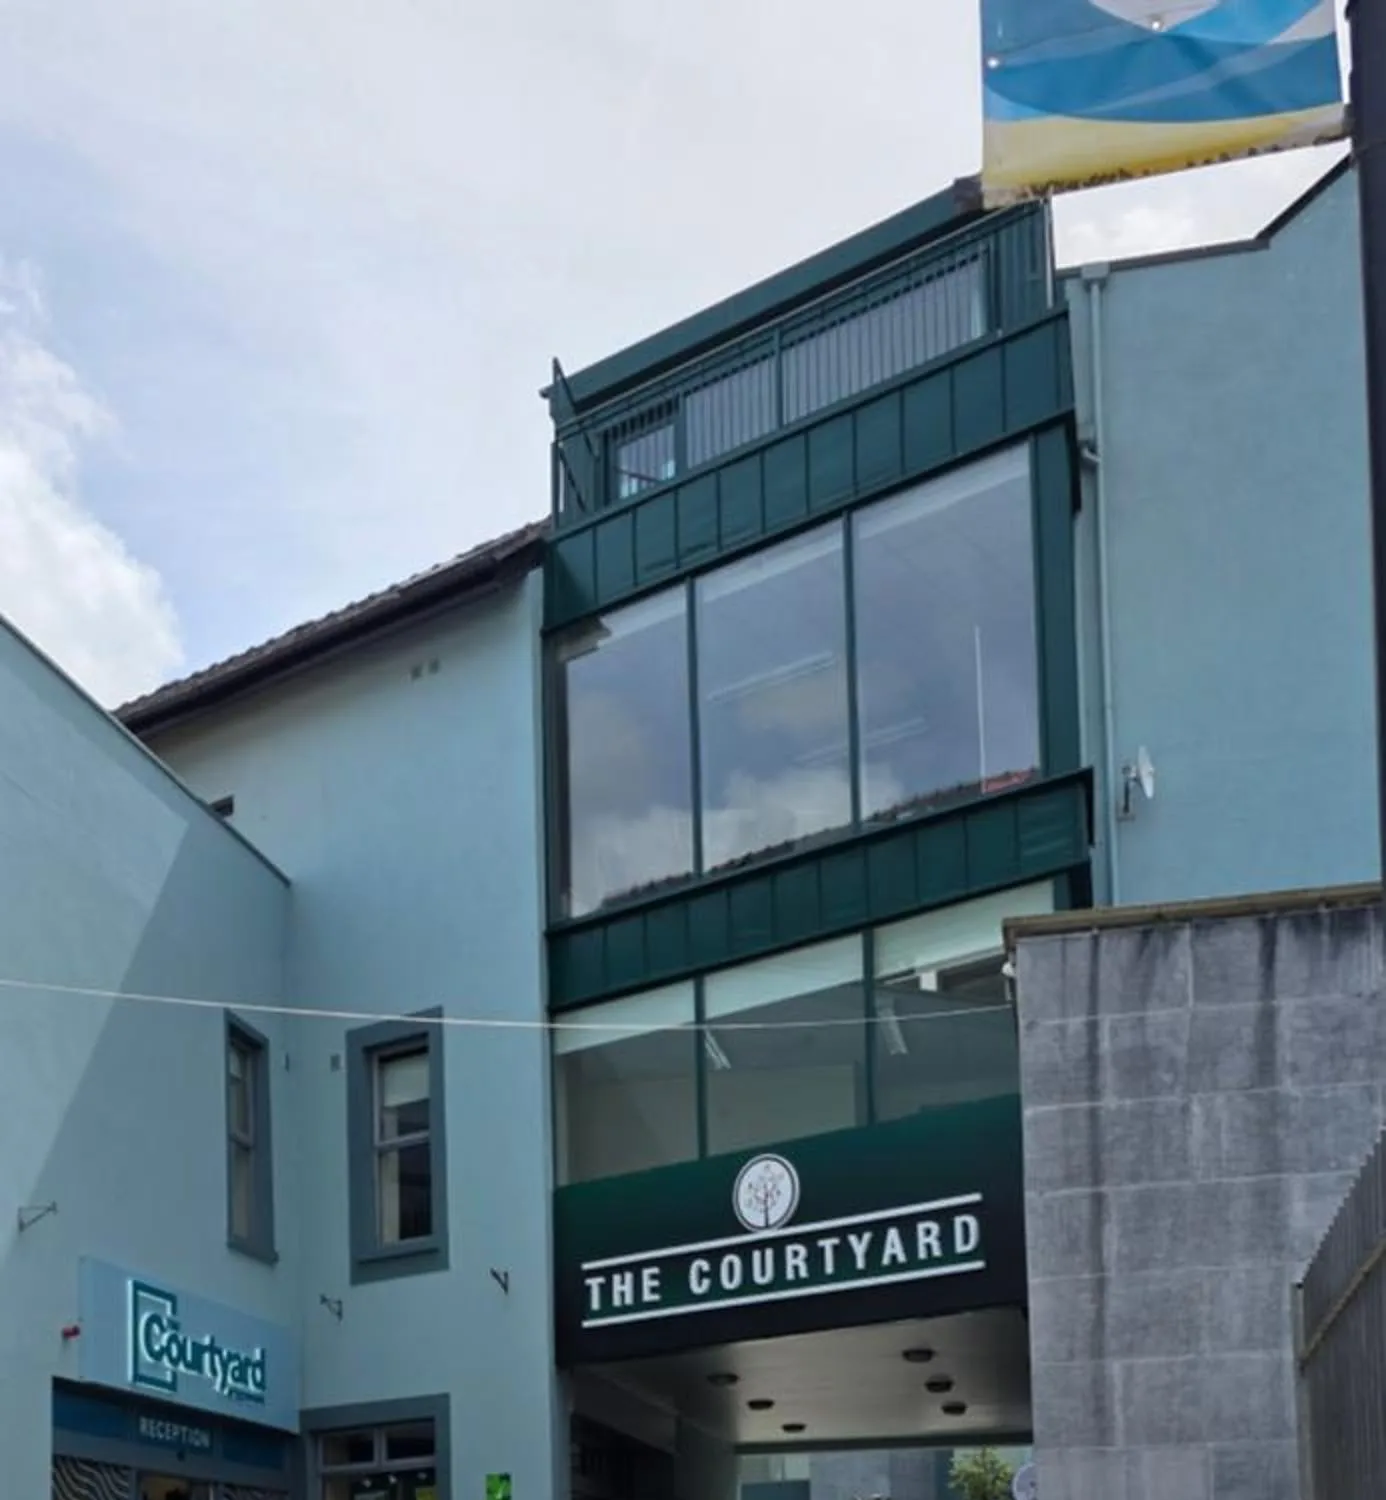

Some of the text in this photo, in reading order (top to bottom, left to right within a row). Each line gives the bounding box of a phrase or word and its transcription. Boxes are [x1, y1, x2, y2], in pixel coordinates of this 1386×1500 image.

[585, 1213, 981, 1311] THE COURTYARD
[140, 1312, 266, 1396] Courtyard
[139, 1416, 211, 1448] RECEPTION
